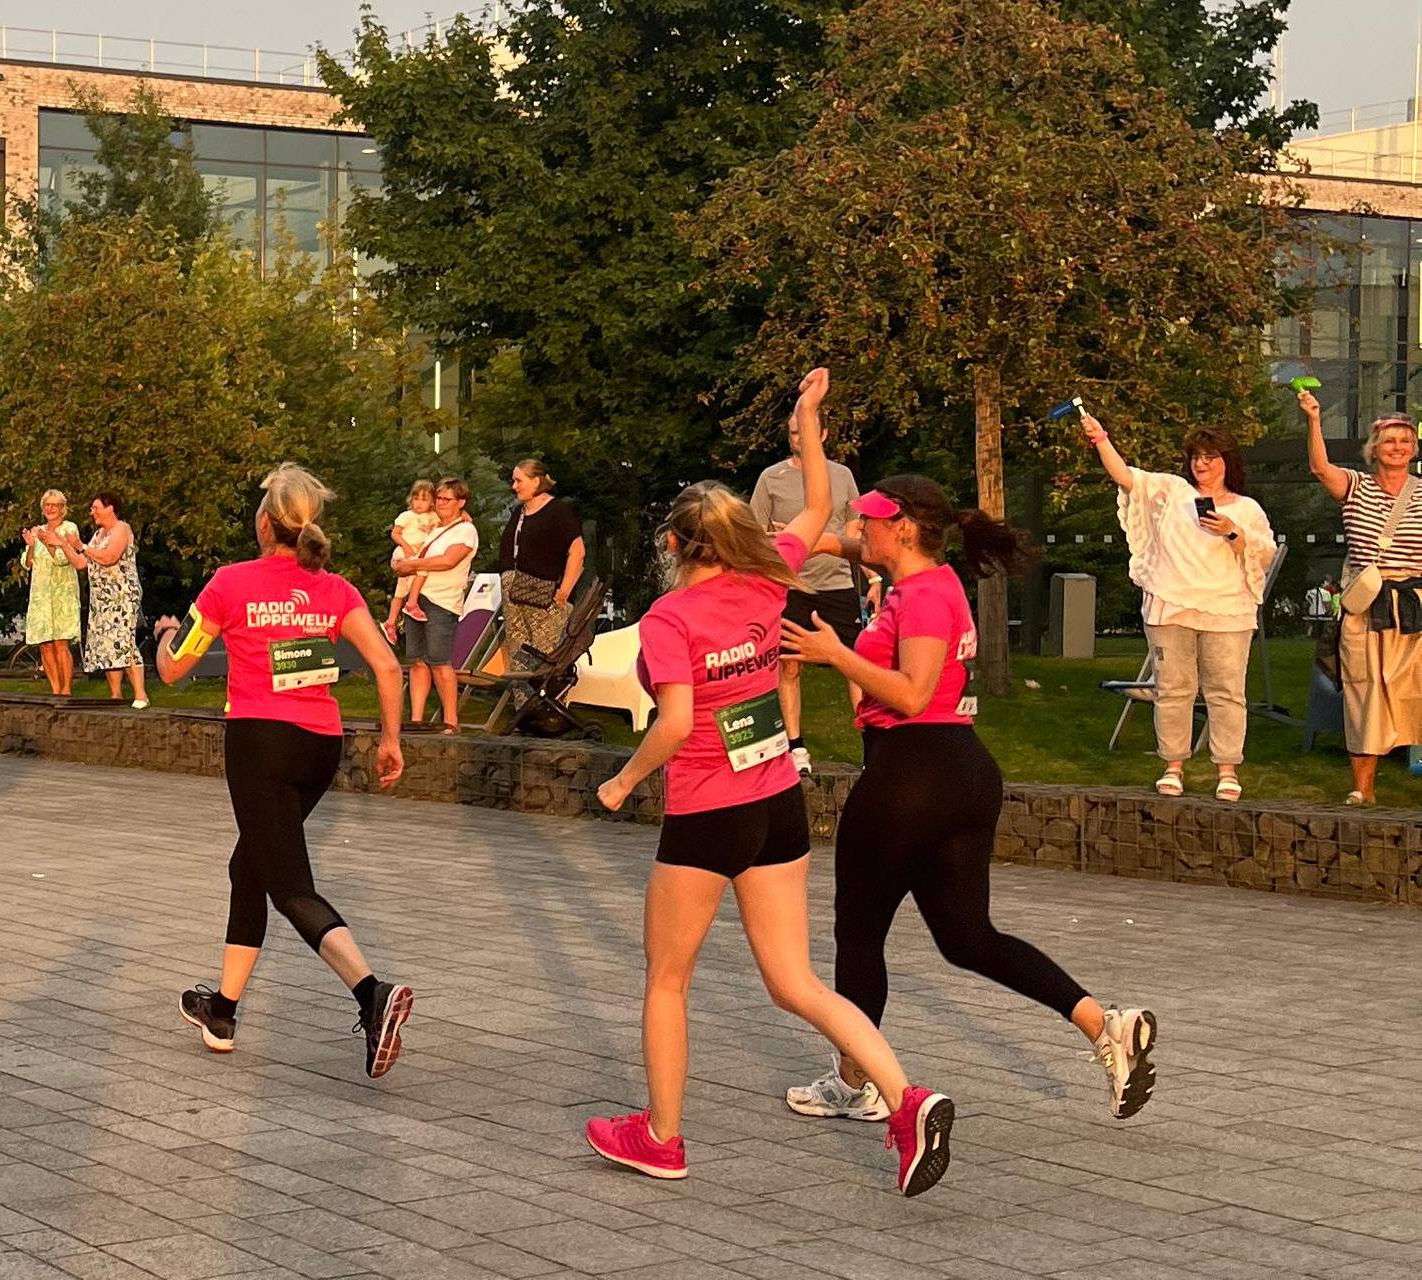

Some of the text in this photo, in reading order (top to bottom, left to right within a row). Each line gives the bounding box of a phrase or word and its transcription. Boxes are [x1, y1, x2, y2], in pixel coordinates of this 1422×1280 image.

[247, 601, 295, 614] RADIO
[247, 613, 337, 628] LIPPEWELLE
[273, 649, 312, 661] Simone
[705, 641, 755, 668] RADIO
[723, 715, 754, 733] Lena
